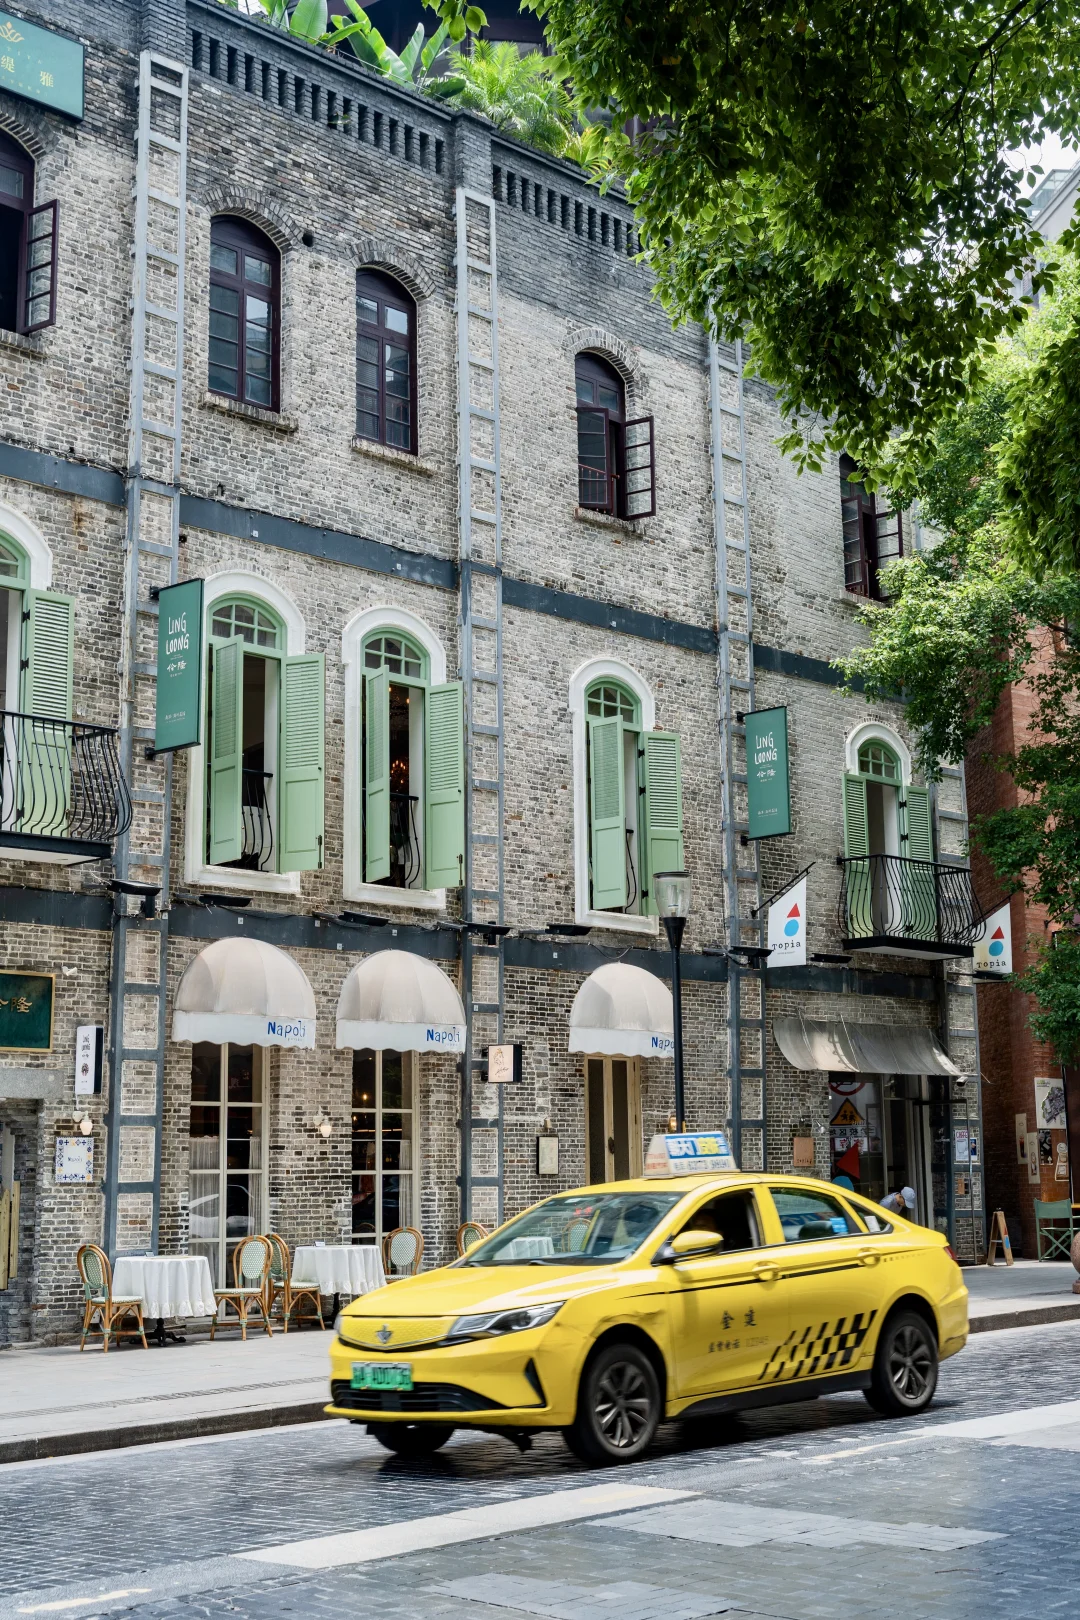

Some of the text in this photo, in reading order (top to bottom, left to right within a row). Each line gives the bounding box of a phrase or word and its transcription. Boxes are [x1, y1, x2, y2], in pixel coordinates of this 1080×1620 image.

[168, 612, 187, 635] LING
[166, 633, 189, 655] LOONG
[755, 732, 774, 749] LING
[754, 748, 778, 765] LOONG
[771, 939, 801, 951] Topia
[976, 959, 1007, 969] Topia
[267, 1020, 306, 1038] Napoli
[426, 1026, 460, 1044] Napoli
[651, 1036, 675, 1050] Napo
